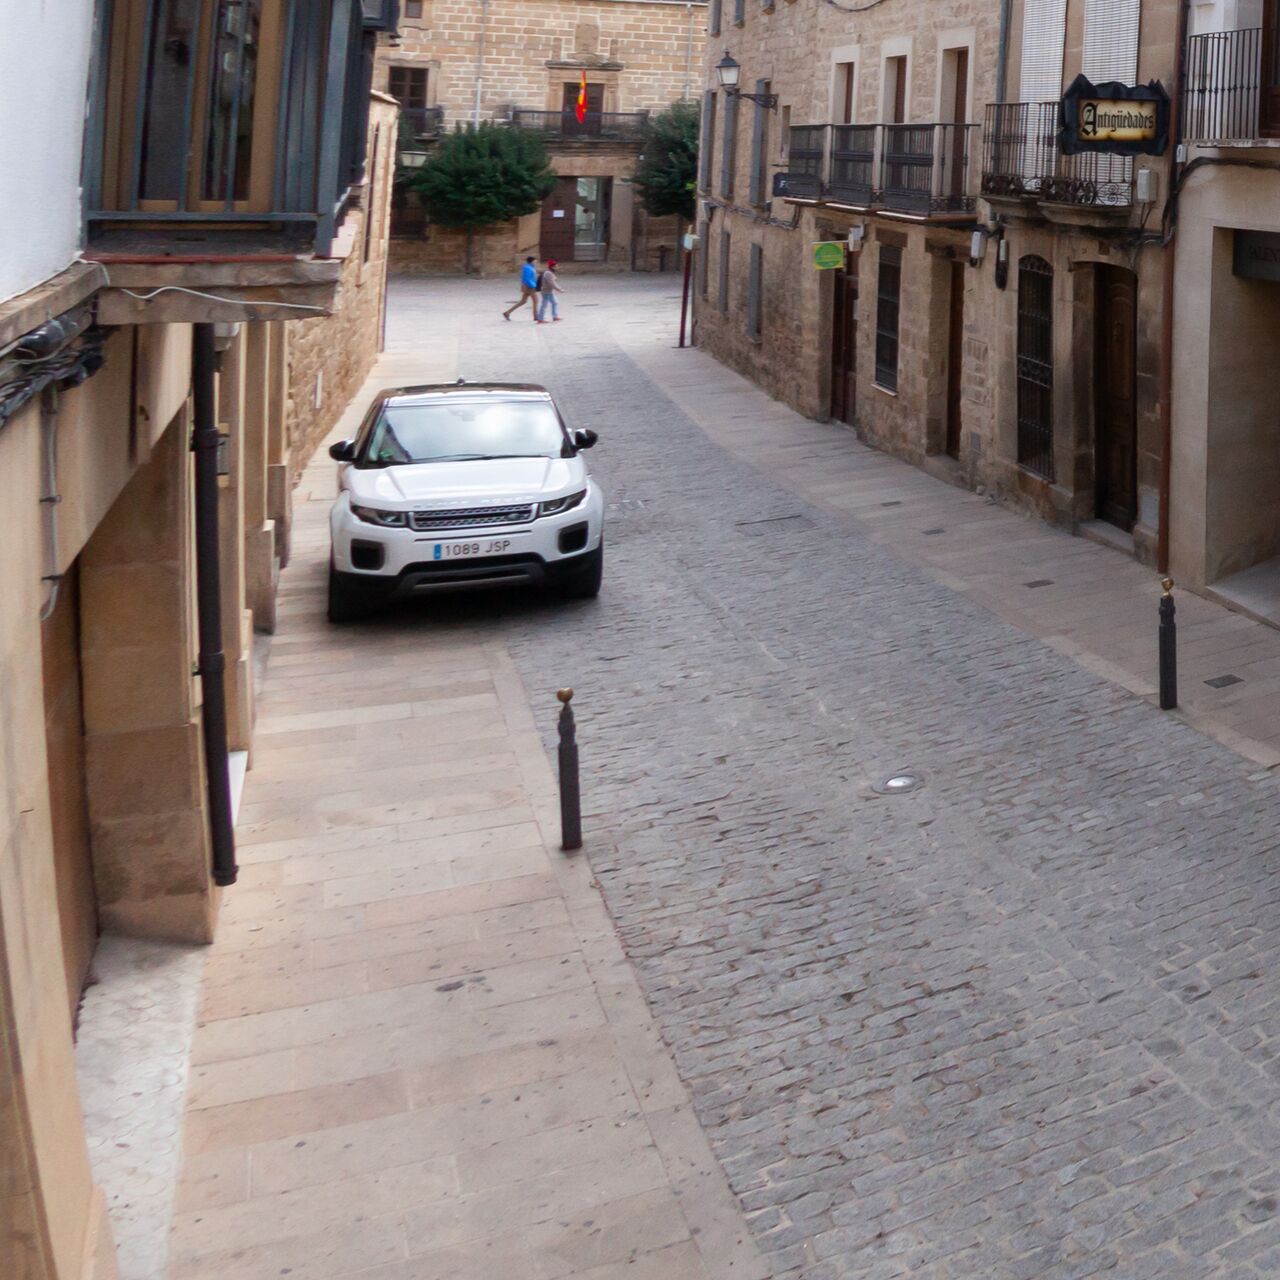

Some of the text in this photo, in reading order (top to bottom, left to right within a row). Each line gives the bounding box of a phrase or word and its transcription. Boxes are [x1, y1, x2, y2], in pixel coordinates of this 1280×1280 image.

[1080, 102, 1154, 136] Antigüedades
[445, 540, 511, 556] 1089 JSP
